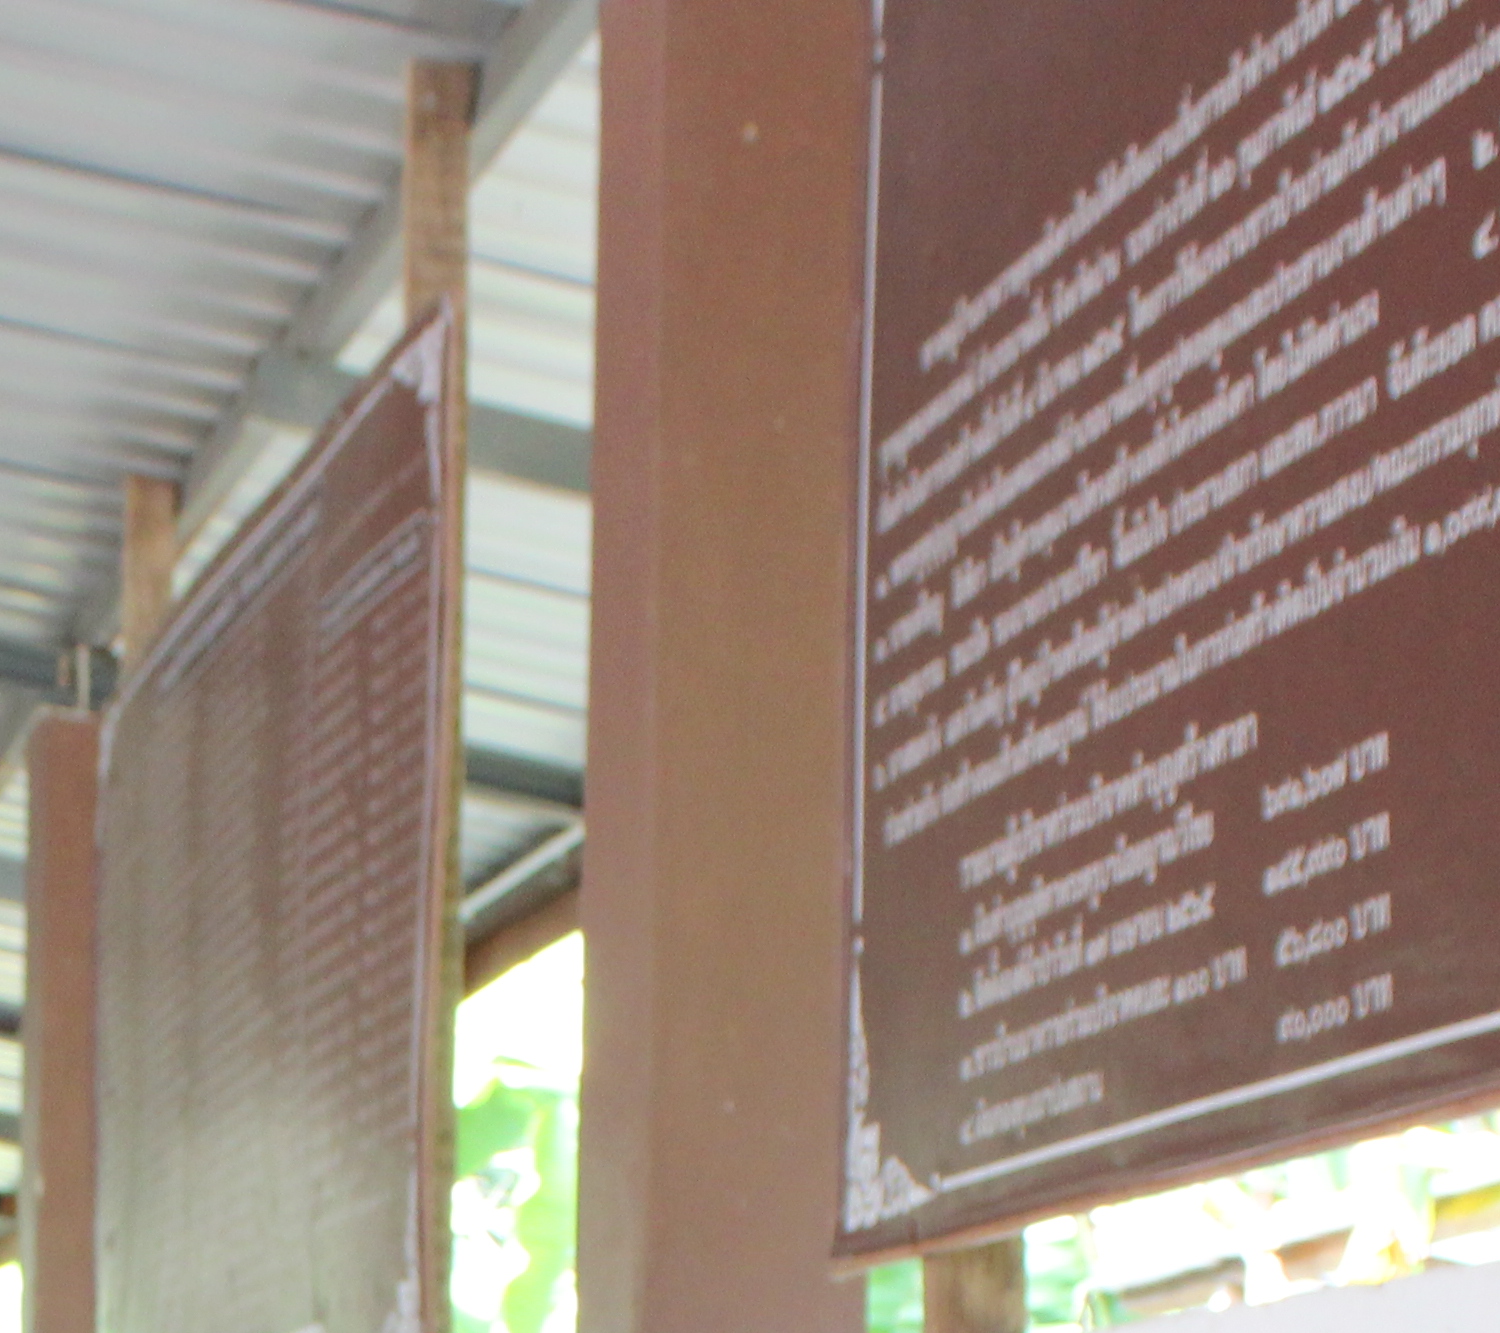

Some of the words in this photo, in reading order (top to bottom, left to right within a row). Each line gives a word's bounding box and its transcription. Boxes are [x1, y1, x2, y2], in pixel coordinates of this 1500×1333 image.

[1350, 733, 1386, 779] บาท
[1351, 813, 1387, 858] บาท
[1214, 948, 1244, 987] บาท
[1352, 894, 1388, 938] บาท
[1354, 974, 1390, 1016] บาท
